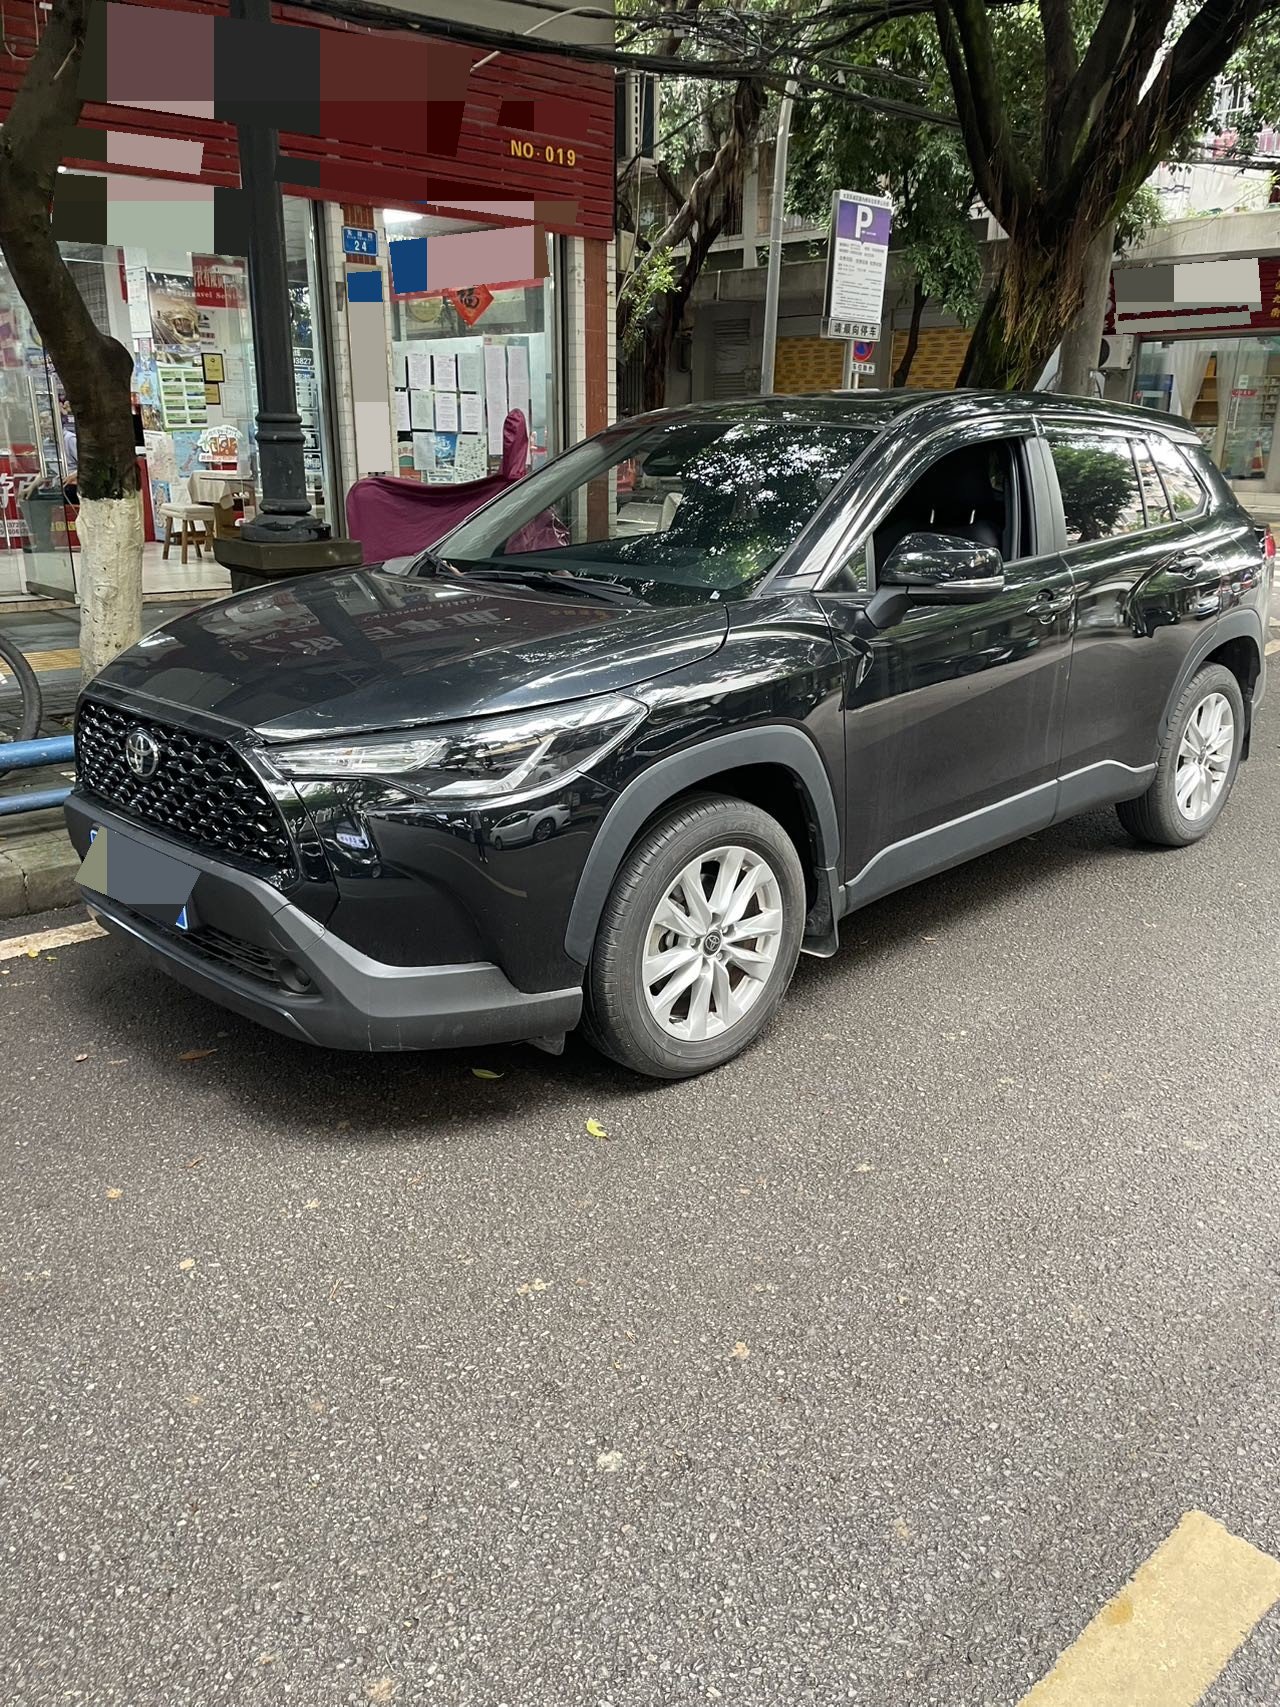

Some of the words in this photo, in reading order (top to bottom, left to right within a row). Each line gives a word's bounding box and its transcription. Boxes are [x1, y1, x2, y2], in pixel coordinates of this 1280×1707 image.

[855, 205, 873, 239] P
[354, 240, 368, 252] 24
[834, 322, 877, 337] 请顺向停车
